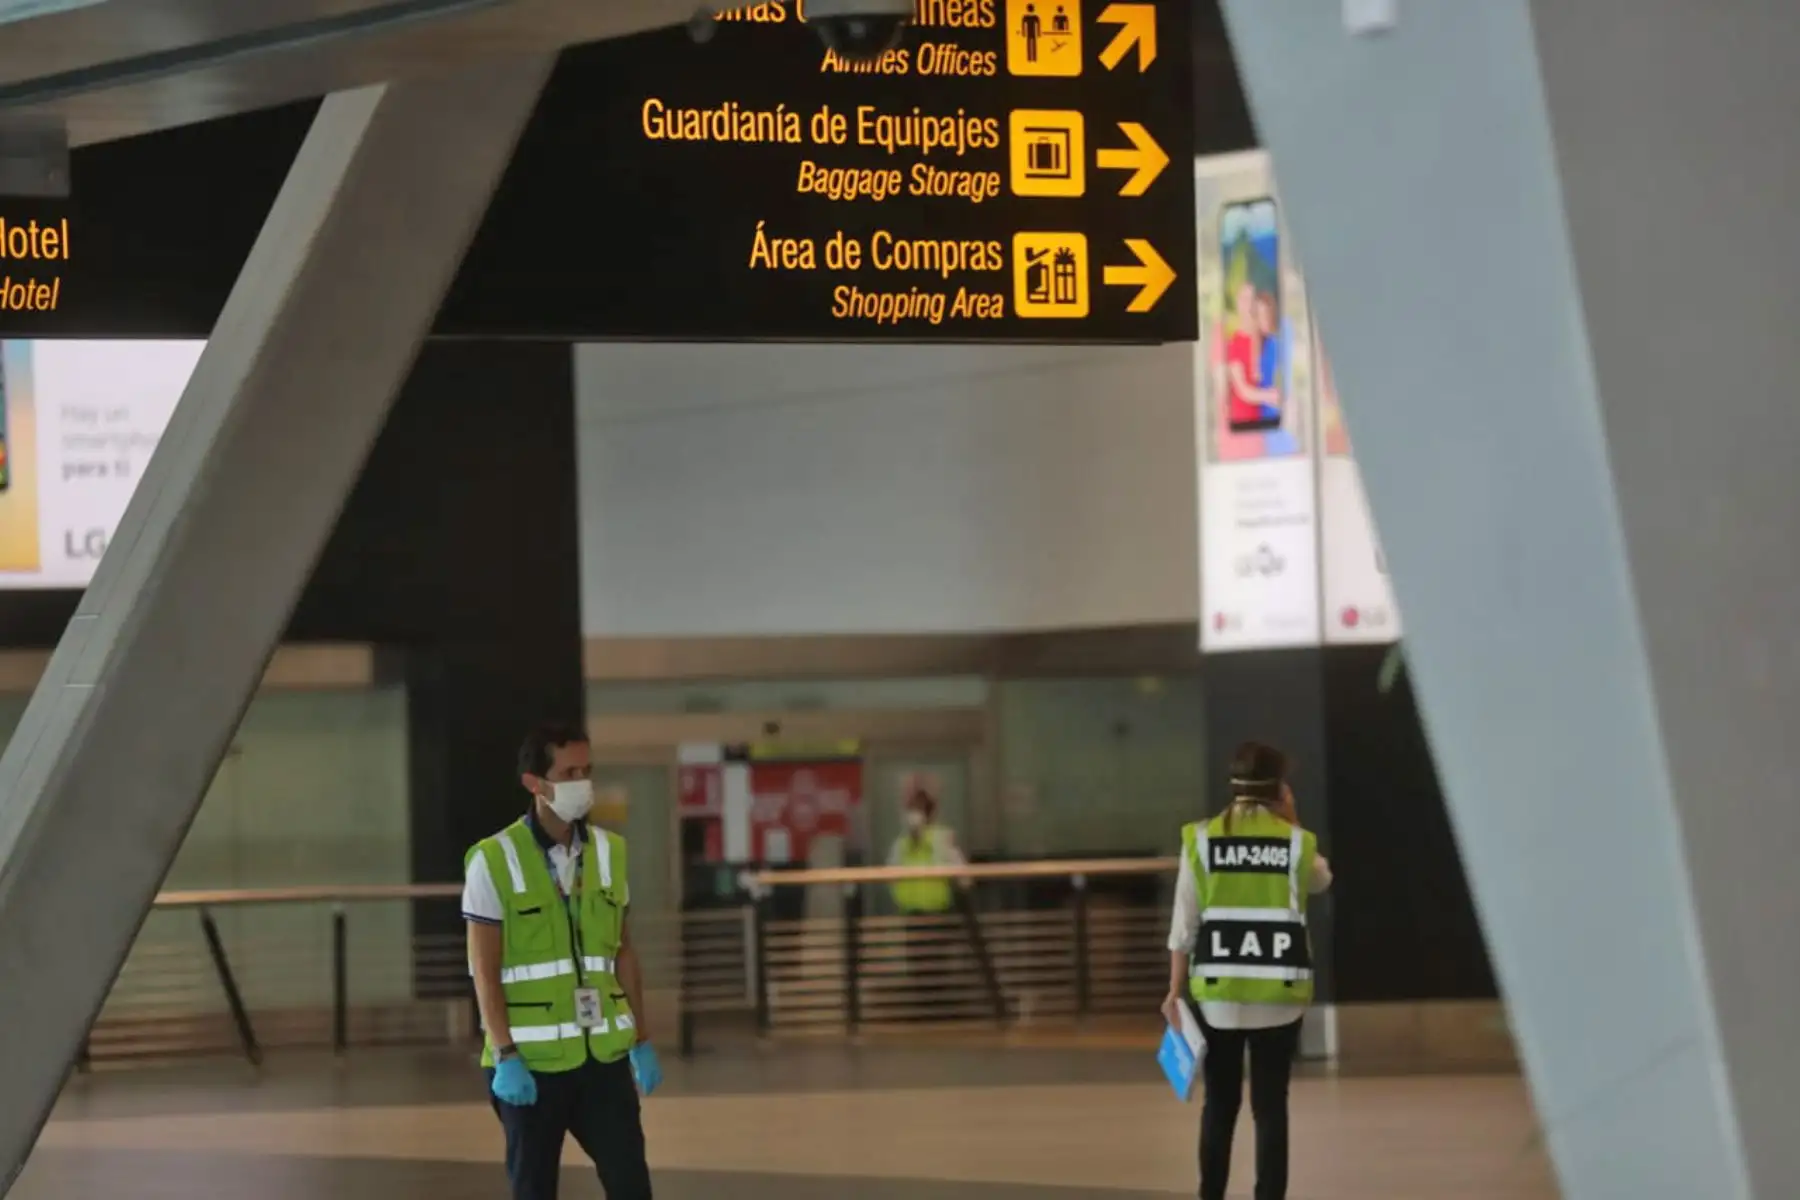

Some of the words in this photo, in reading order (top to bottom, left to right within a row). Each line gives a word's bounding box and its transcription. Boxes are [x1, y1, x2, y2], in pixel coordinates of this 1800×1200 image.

[916, 43, 997, 77] Offices
[642, 98, 802, 144] Guardianía
[810, 105, 848, 144] de
[857, 106, 999, 156] Equipajes
[797, 161, 903, 202] Baggage
[908, 163, 1001, 204] Storage
[749, 220, 817, 270] Área
[824, 230, 862, 271] de
[871, 230, 1004, 279] Compras
[831, 285, 947, 325] Shopping
[949, 286, 1005, 319] Area
[1214, 844, 1289, 868] LAP-2405
